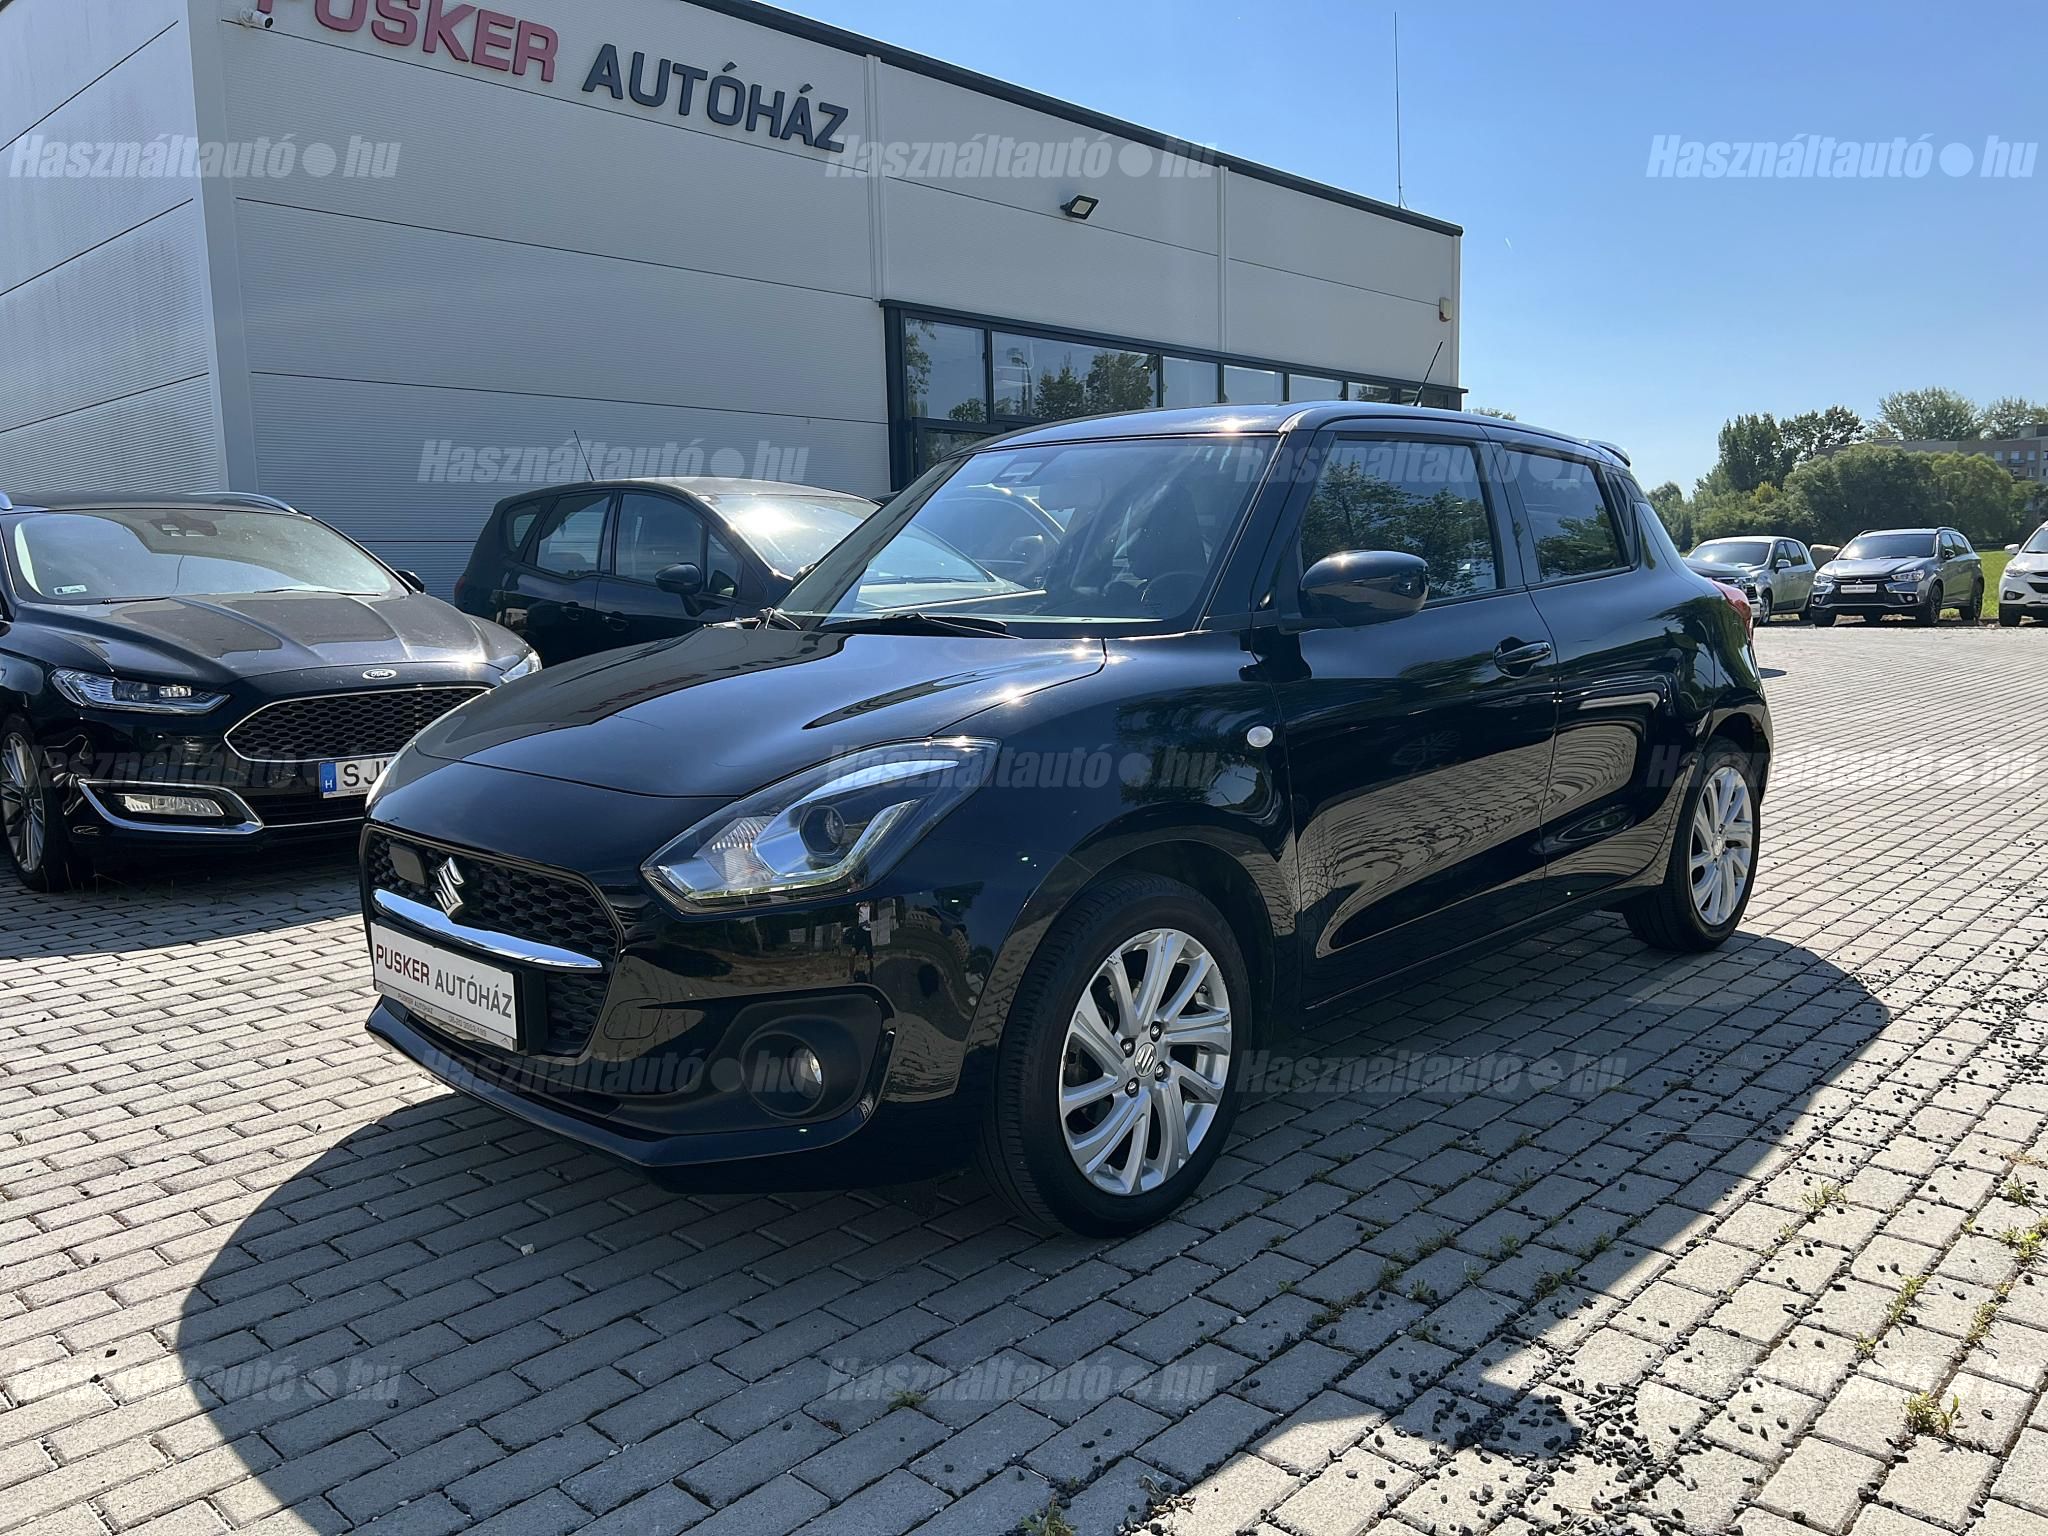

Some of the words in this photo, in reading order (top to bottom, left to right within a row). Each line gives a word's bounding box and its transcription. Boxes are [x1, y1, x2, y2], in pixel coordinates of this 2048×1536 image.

[256, 0, 559, 82] USKER
[582, 43, 849, 153] AUTÓHÁZ
[325, 779, 333, 789] H
[375, 943, 430, 986] PUSKER
[434, 969, 513, 1019] AUTÓHÁZ
